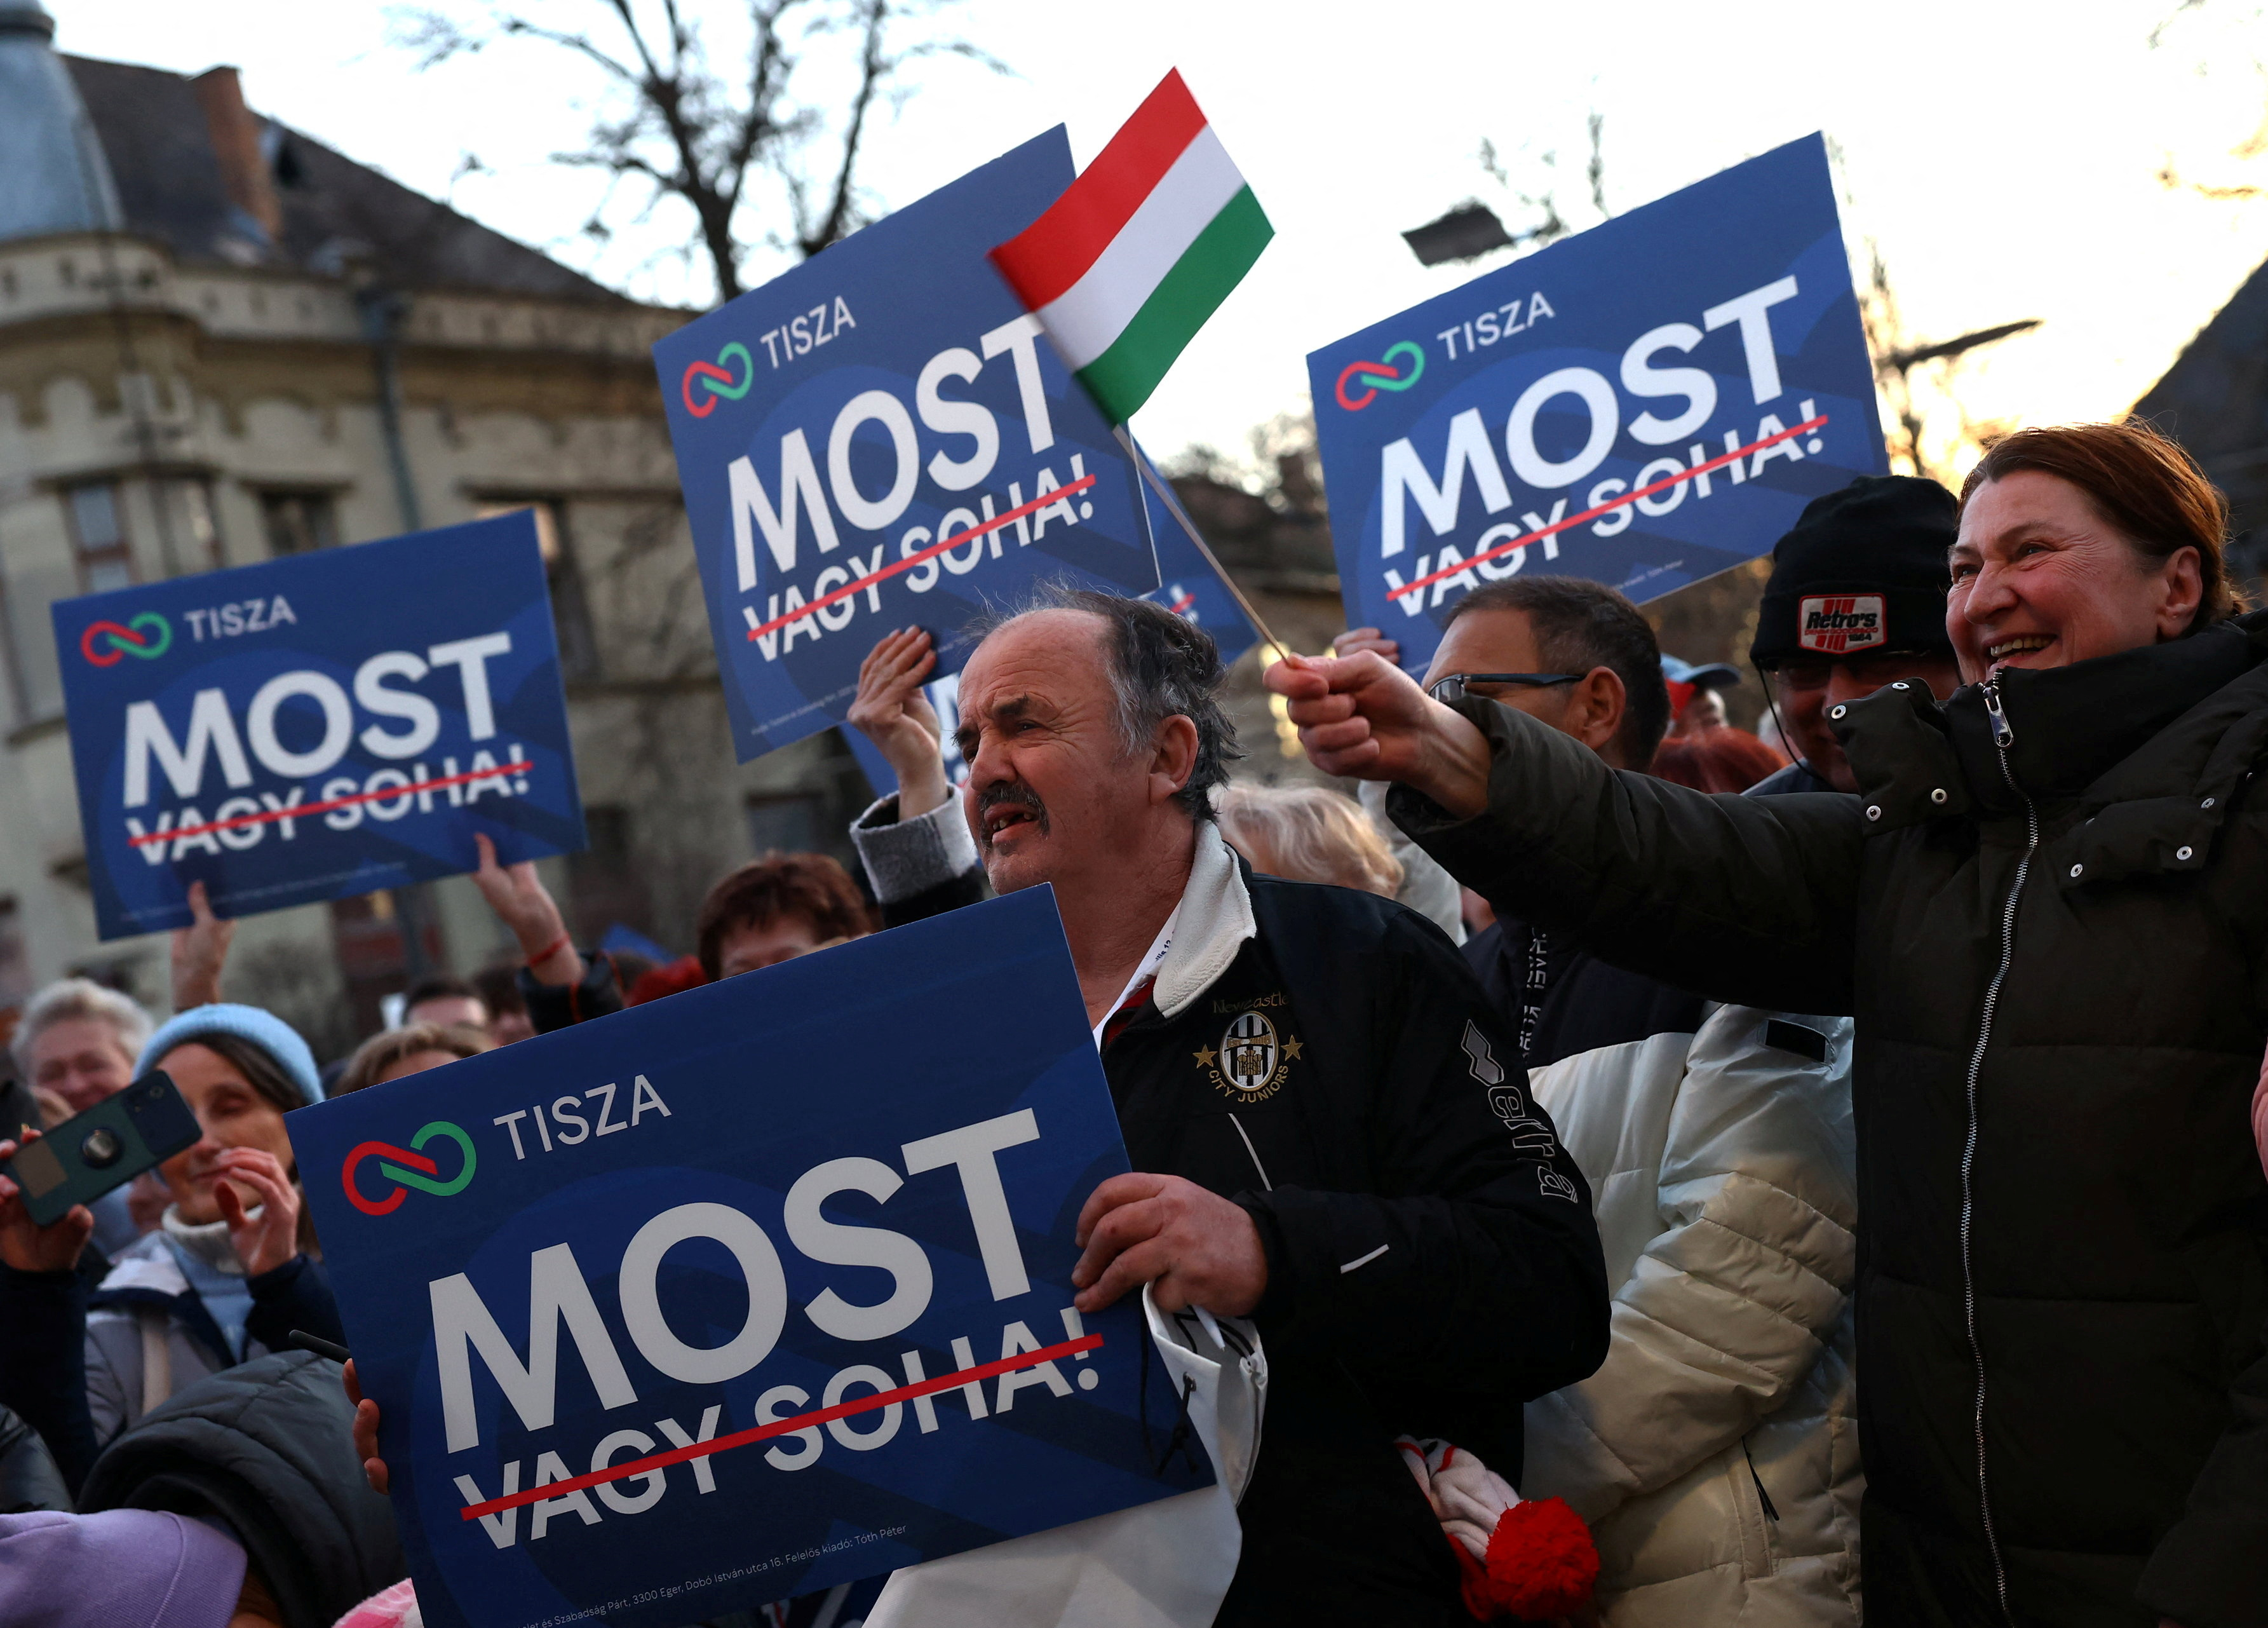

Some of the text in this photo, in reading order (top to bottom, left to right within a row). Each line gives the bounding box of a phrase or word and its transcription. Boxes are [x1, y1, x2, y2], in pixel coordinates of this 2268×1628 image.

[760, 295, 856, 369] TISZA
[1437, 292, 1554, 360] TISZA
[728, 313, 1055, 592] MOST
[1382, 275, 1798, 559] MOST
[743, 453, 1094, 661] VAGY SOHA!
[1384, 398, 1823, 616] VAGY SOHA!
[184, 595, 297, 642] TISZA
[1806, 610, 1877, 629] Retro's
[124, 632, 511, 808] MOST
[126, 744, 534, 865] VAGY SOHA!
[1214, 991, 1290, 1014] Newcastle
[493, 1074, 672, 1160] TISZA
[1209, 1065, 1289, 1103] CITY JUNIORS
[429, 1107, 1041, 1455] MOST
[452, 1305, 1099, 1550] VAGY SOHA!
[541, 1618, 553, 1628] és
[554, 1605, 607, 1625] Szabadság
[607, 1598, 631, 1611] Párt,
[631, 1589, 658, 1604] 3300
[659, 1583, 684, 1598] Eger,
[685, 1575, 713, 1591] Dobó
[714, 1567, 745, 1583] István
[746, 1561, 769, 1574] utca
[770, 1557, 784, 1568] 16.
[785, 1547, 821, 1564] Felelős
[823, 1538, 853, 1555] kiadó:
[854, 1531, 878, 1545] Tóth
[879, 1524, 907, 1539] Péter
